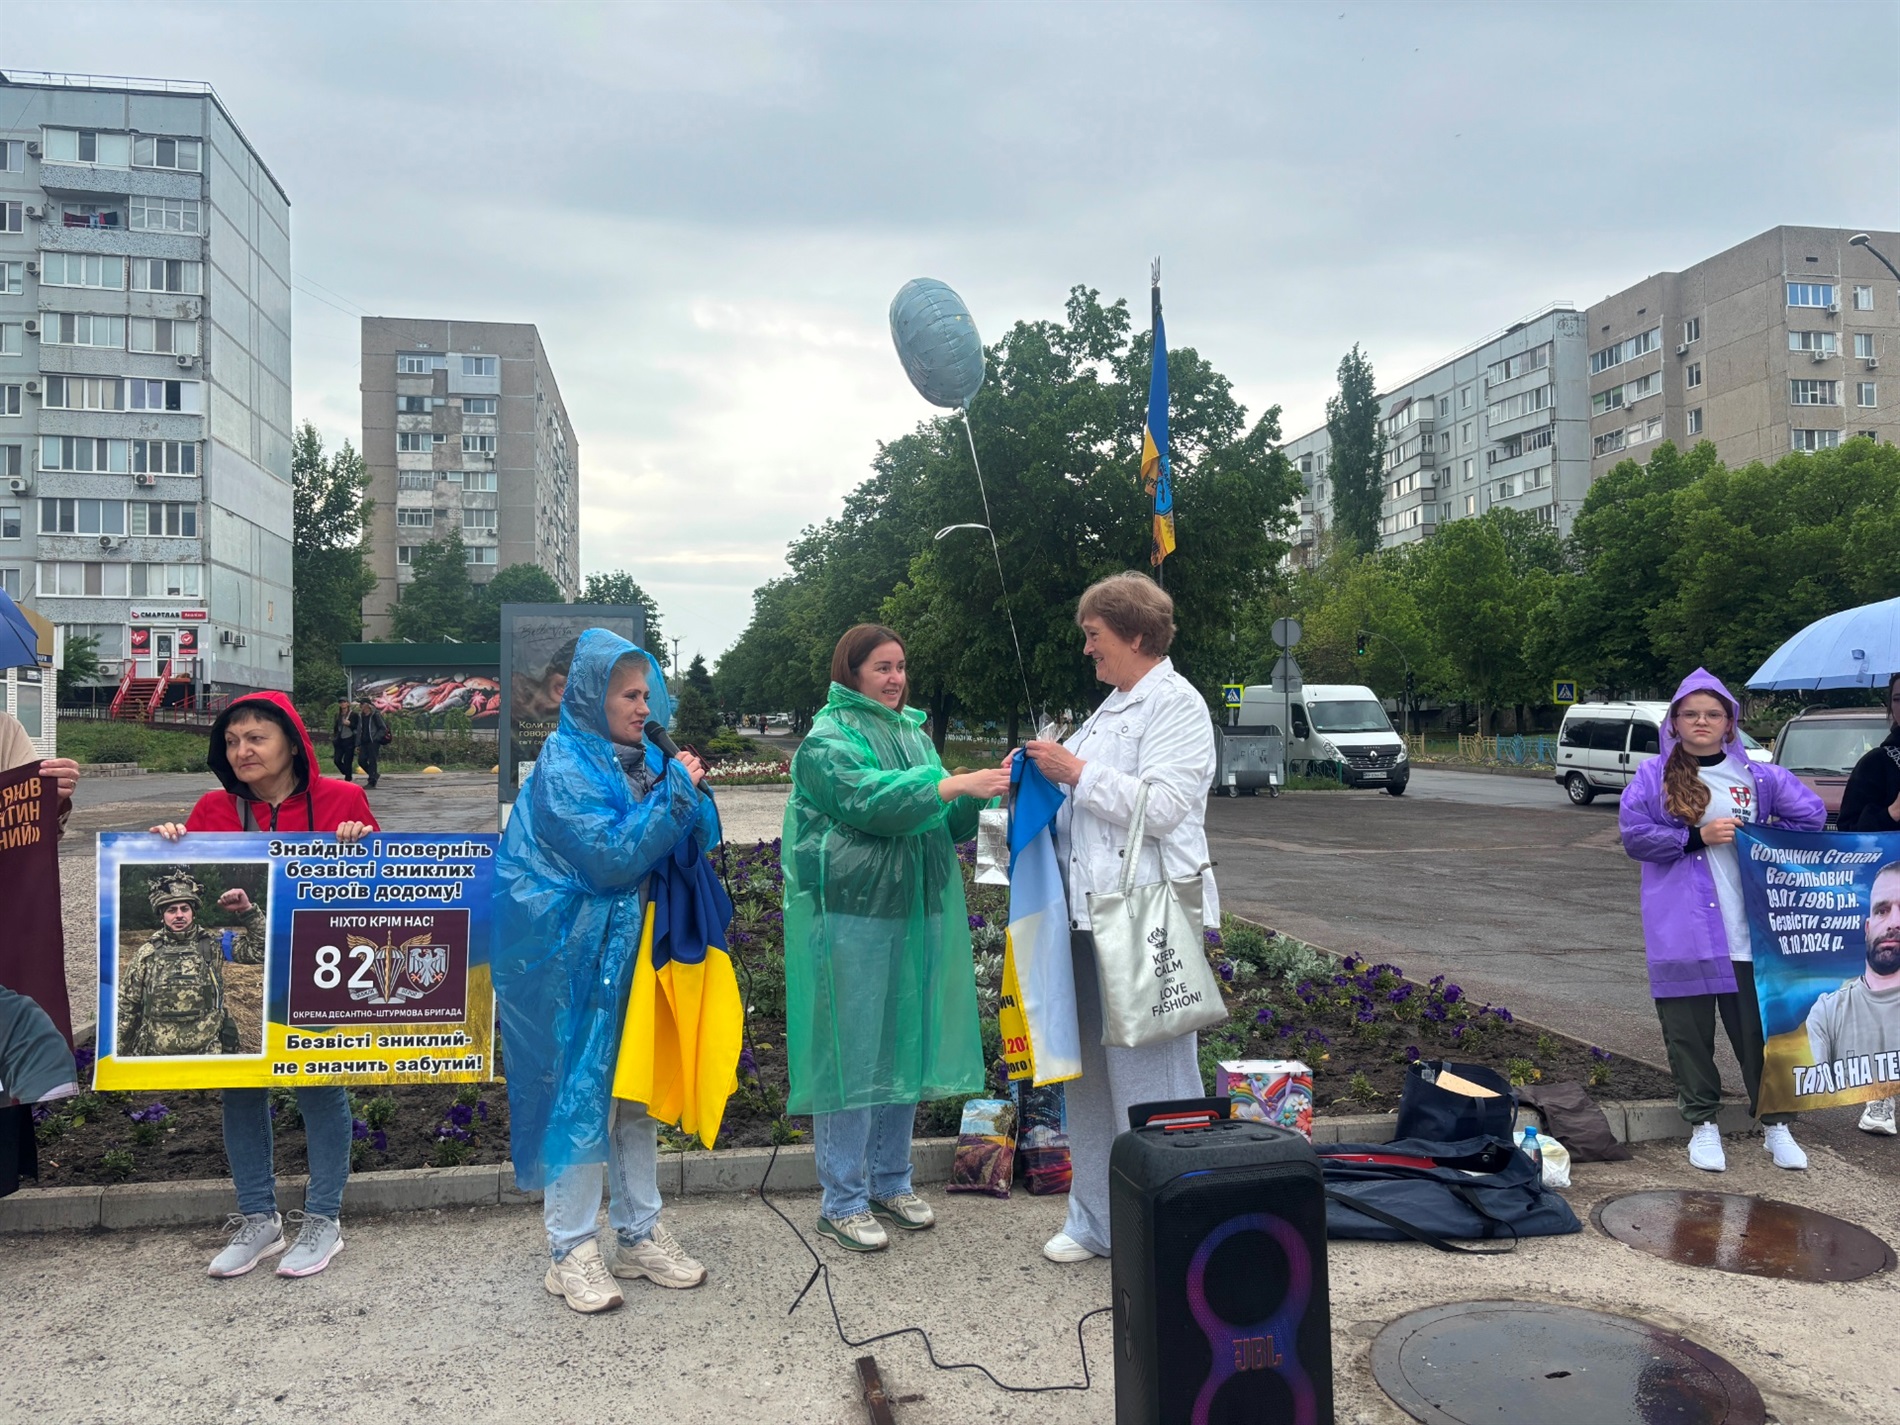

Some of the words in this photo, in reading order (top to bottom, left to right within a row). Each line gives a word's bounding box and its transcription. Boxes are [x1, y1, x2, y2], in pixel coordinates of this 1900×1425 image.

[519, 721, 543, 729] Коли
[269, 841, 367, 859] Знайдіть
[374, 841, 380, 856] і
[387, 842, 492, 860] поверніть
[1823, 849, 1882, 864] Степан
[286, 862, 375, 877] безвісті
[382, 864, 474, 878] зниклих
[1766, 867, 1854, 887] Васильович
[298, 883, 369, 901] Героїв
[375, 883, 462, 901] додому!
[1837, 893, 1860, 910] р.н.
[330, 916, 367, 927] НІХТО
[370, 916, 401, 927] КРІМ
[404, 916, 434, 926] НАС!
[1768, 911, 1819, 931] Безвісти
[1821, 915, 1860, 930] зник
[1778, 933, 1831, 955] 18.10.2024
[1832, 935, 1844, 952] р.
[1152, 948, 1175, 965] KEEP
[313, 945, 376, 989] 82
[1154, 959, 1183, 978] CALM
[1164, 976, 1175, 984] AND
[1160, 982, 1187, 1000] LOVE
[1152, 991, 1203, 1017] FASHION!
[293, 1010, 327, 1019] ОКРЕМА
[328, 1009, 423, 1018] ДЕСАНТНО-ШТУРМОВА
[424, 1008, 462, 1016] БРИГАДА
[287, 1034, 370, 1049] Безвісті
[377, 1032, 472, 1047] зниклий-
[273, 1061, 298, 1074] не
[305, 1059, 388, 1074] значить
[395, 1056, 482, 1074] забутий!
[1008, 1060, 1028, 1074] ого
[1792, 1062, 1835, 1097] ТАТО
[1833, 1059, 1846, 1091] Я
[1847, 1054, 1873, 1088] НА
[1874, 1050, 1900, 1083] ТЕ
[1233, 1336, 1282, 1370] JBL
